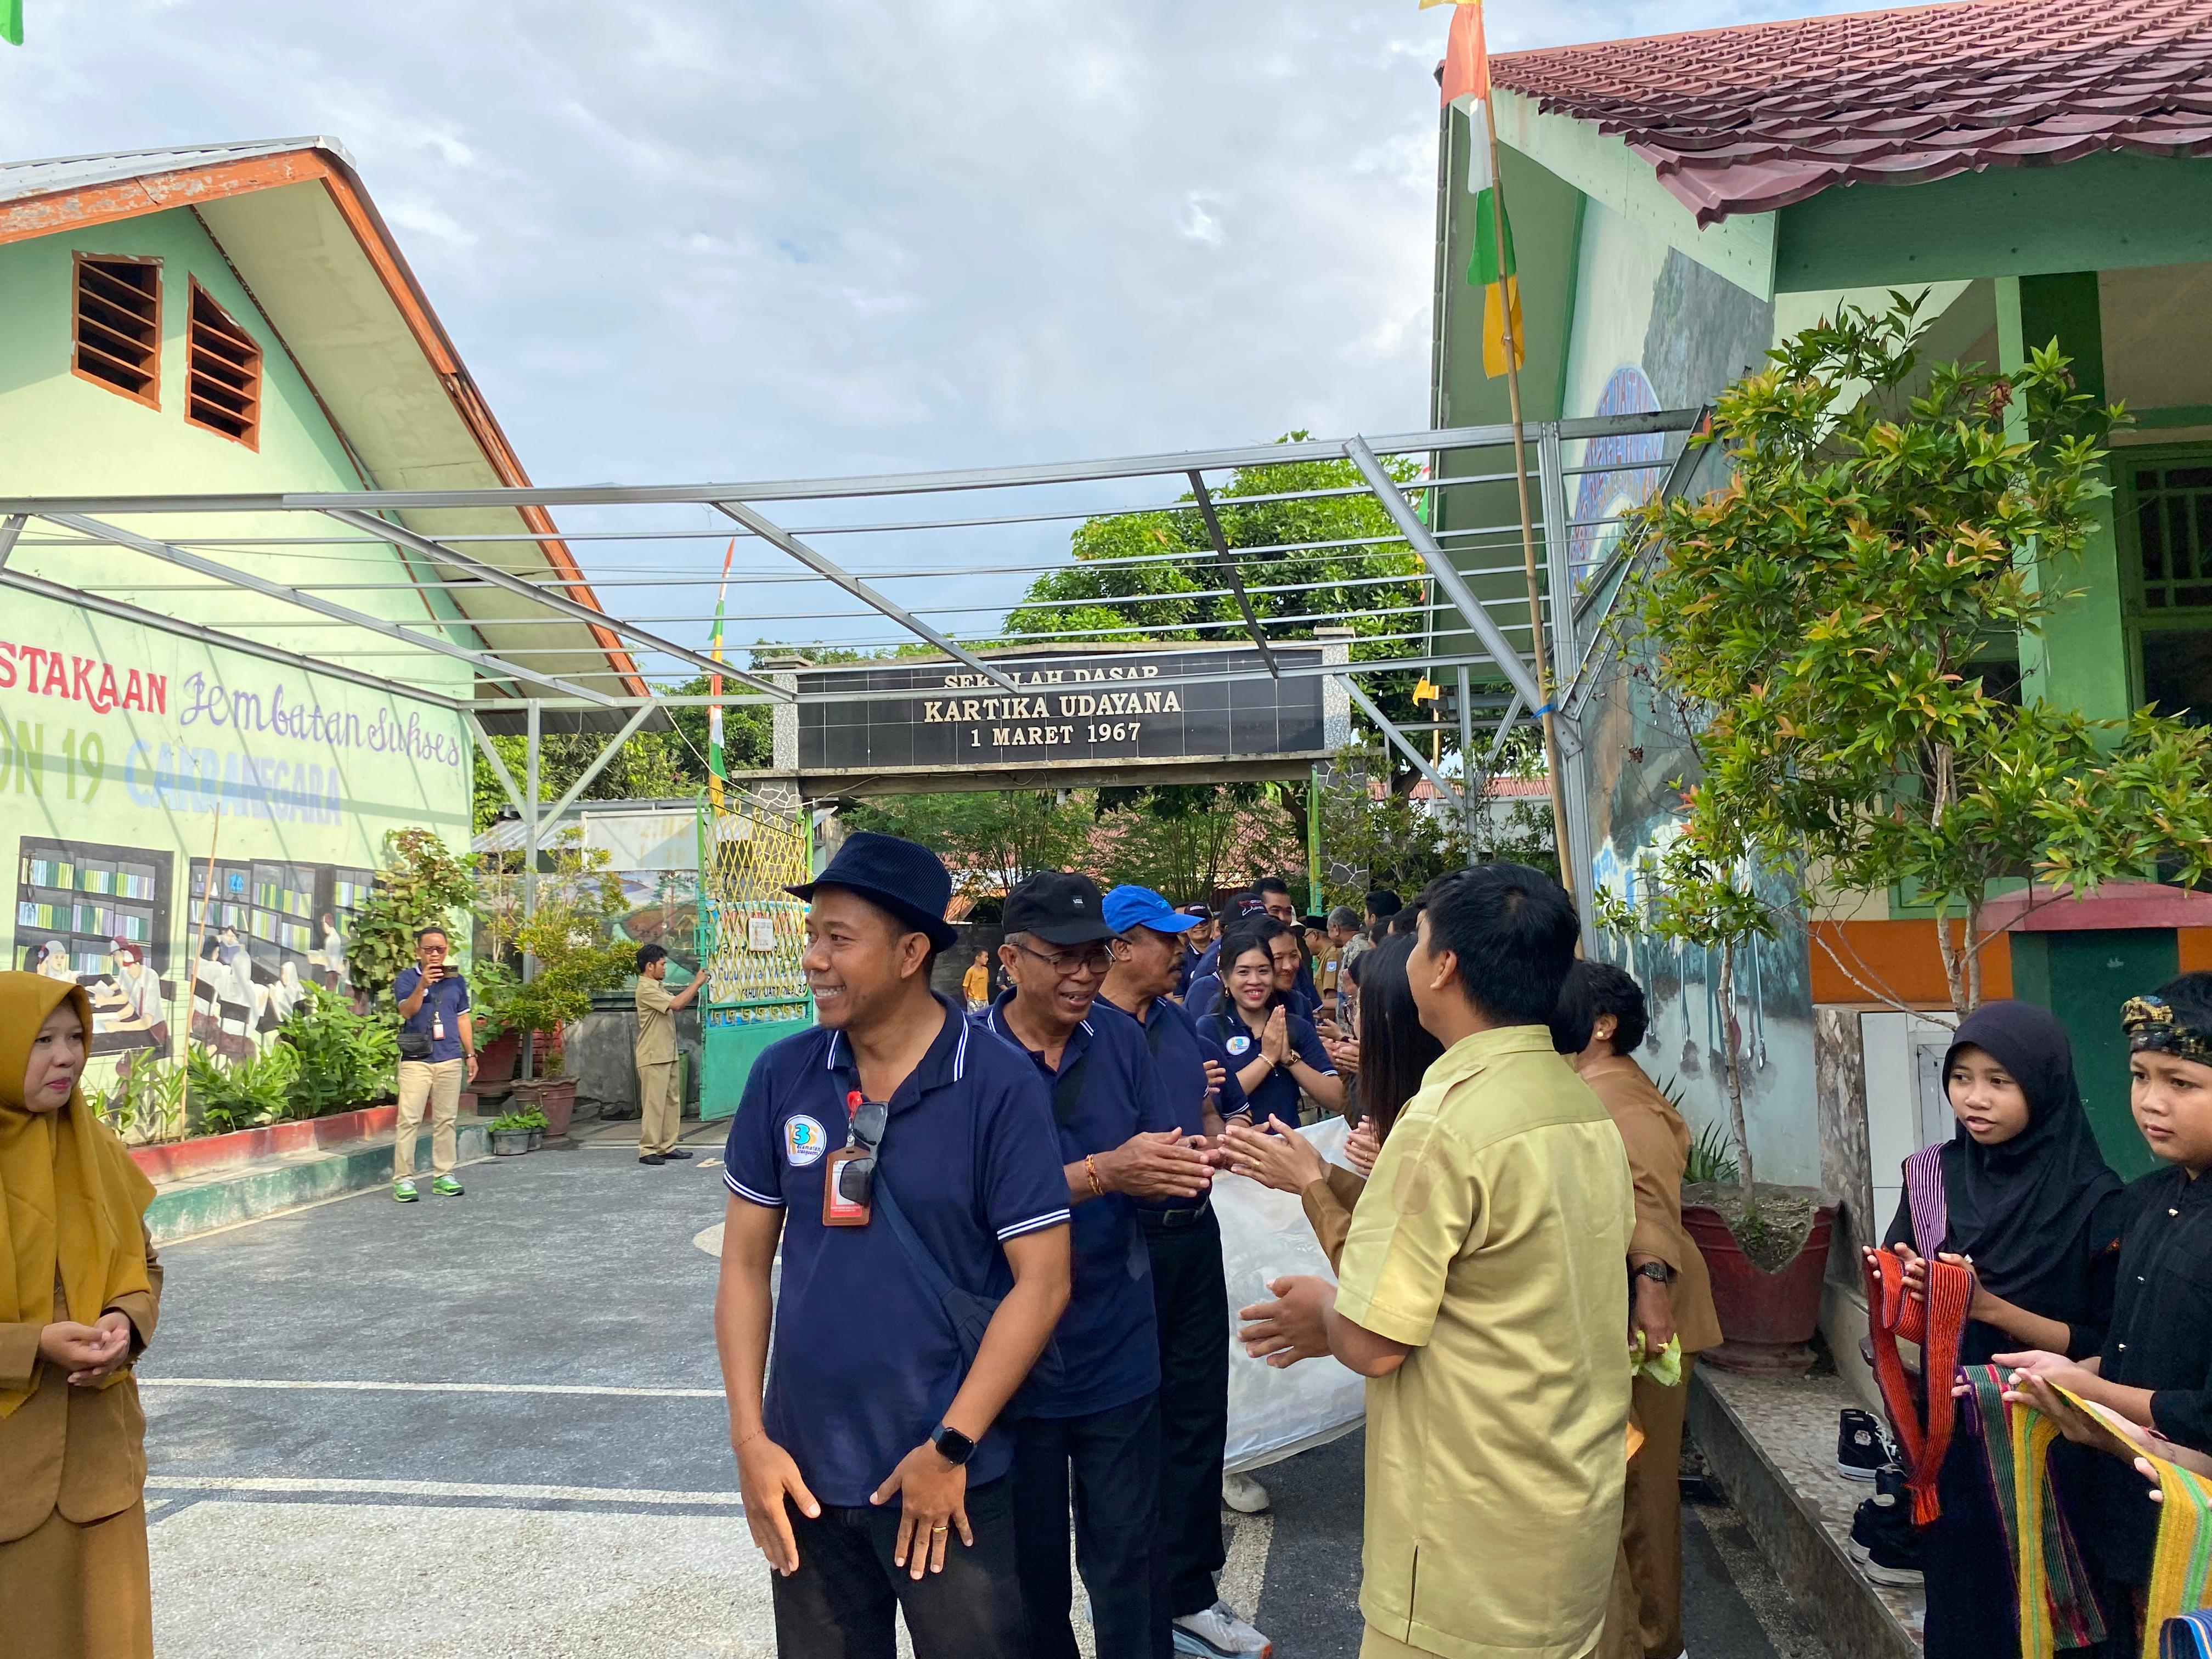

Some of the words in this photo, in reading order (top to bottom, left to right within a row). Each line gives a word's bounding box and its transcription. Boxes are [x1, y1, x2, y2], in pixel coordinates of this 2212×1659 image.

[0, 640, 167, 714] STAKAAN
[944, 670, 1064, 689] SEKLAH
[180, 671, 362, 747] Jembatan
[368, 707, 460, 767] Sukses
[924, 696, 1050, 723] KARTIKA
[1059, 690, 1182, 717] UDAYANA
[971, 729, 981, 748] 1
[992, 725, 1074, 747] MARET
[1087, 722, 1141, 743] 1967
[62, 728, 105, 805] 19
[124, 738, 342, 826] CAKRANEGARA
